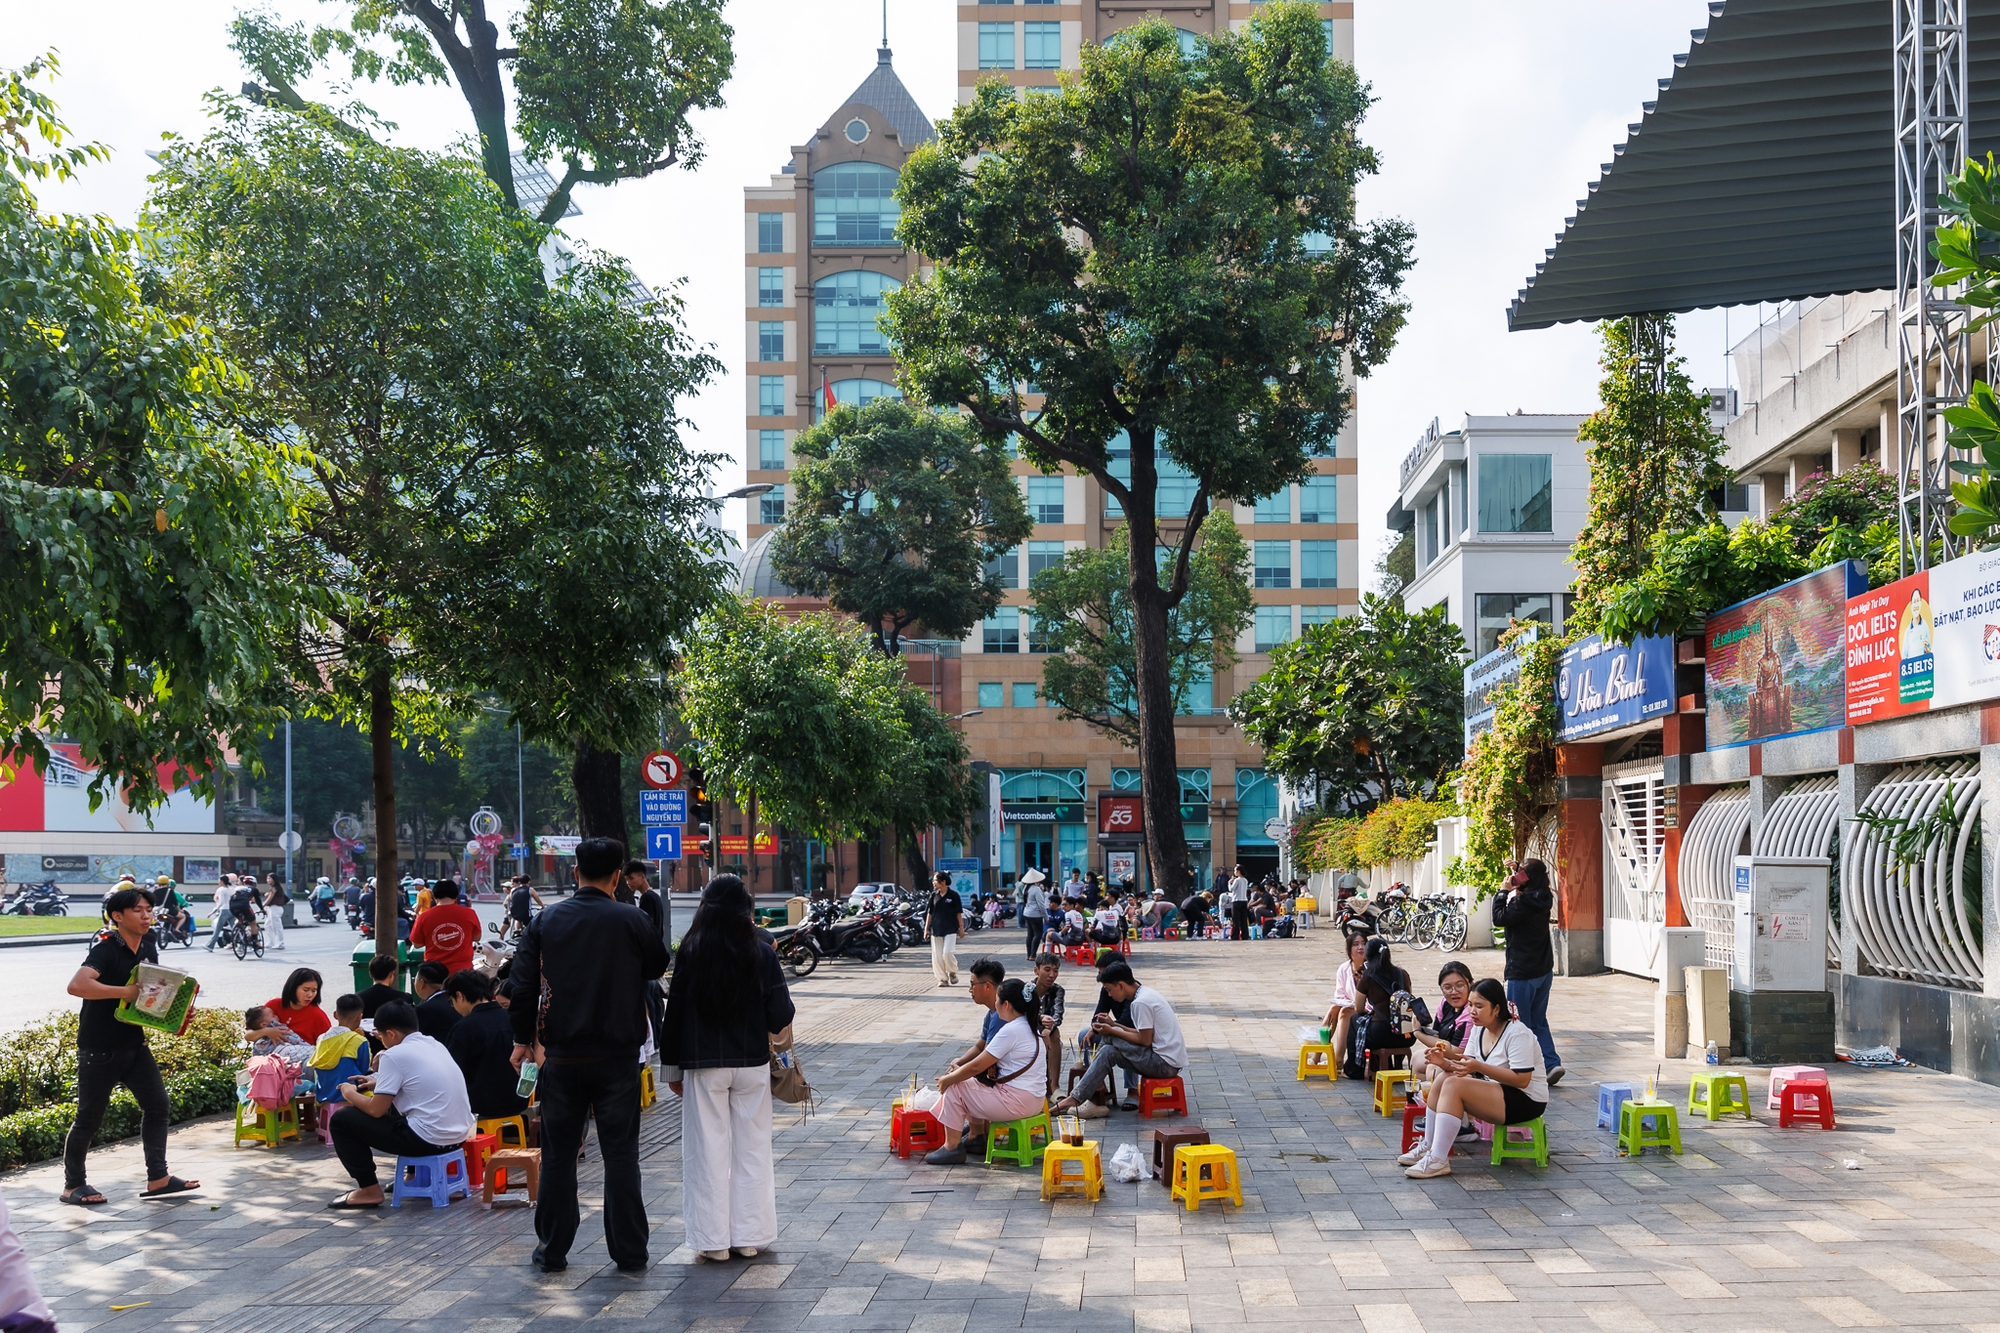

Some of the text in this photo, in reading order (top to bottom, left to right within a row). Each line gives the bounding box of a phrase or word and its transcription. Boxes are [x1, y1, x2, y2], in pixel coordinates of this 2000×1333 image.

[1963, 588, 1976, 602] KHI
[1978, 581, 1994, 597] CÁC
[1848, 606, 1858, 618] Anh
[1879, 596, 1890, 606] Duy
[1967, 604, 1983, 619] BẠO
[1848, 610, 1897, 643] DOL IELTS
[1848, 637, 1895, 668] ĐÌNH LỰC
[1901, 658, 1933, 676] 8.5 IELTS
[1567, 669, 1604, 717] Hòa
[1606, 652, 1647, 705] Bình
[646, 802, 658, 811] VÀO
[1110, 810, 1132, 824] 5G
